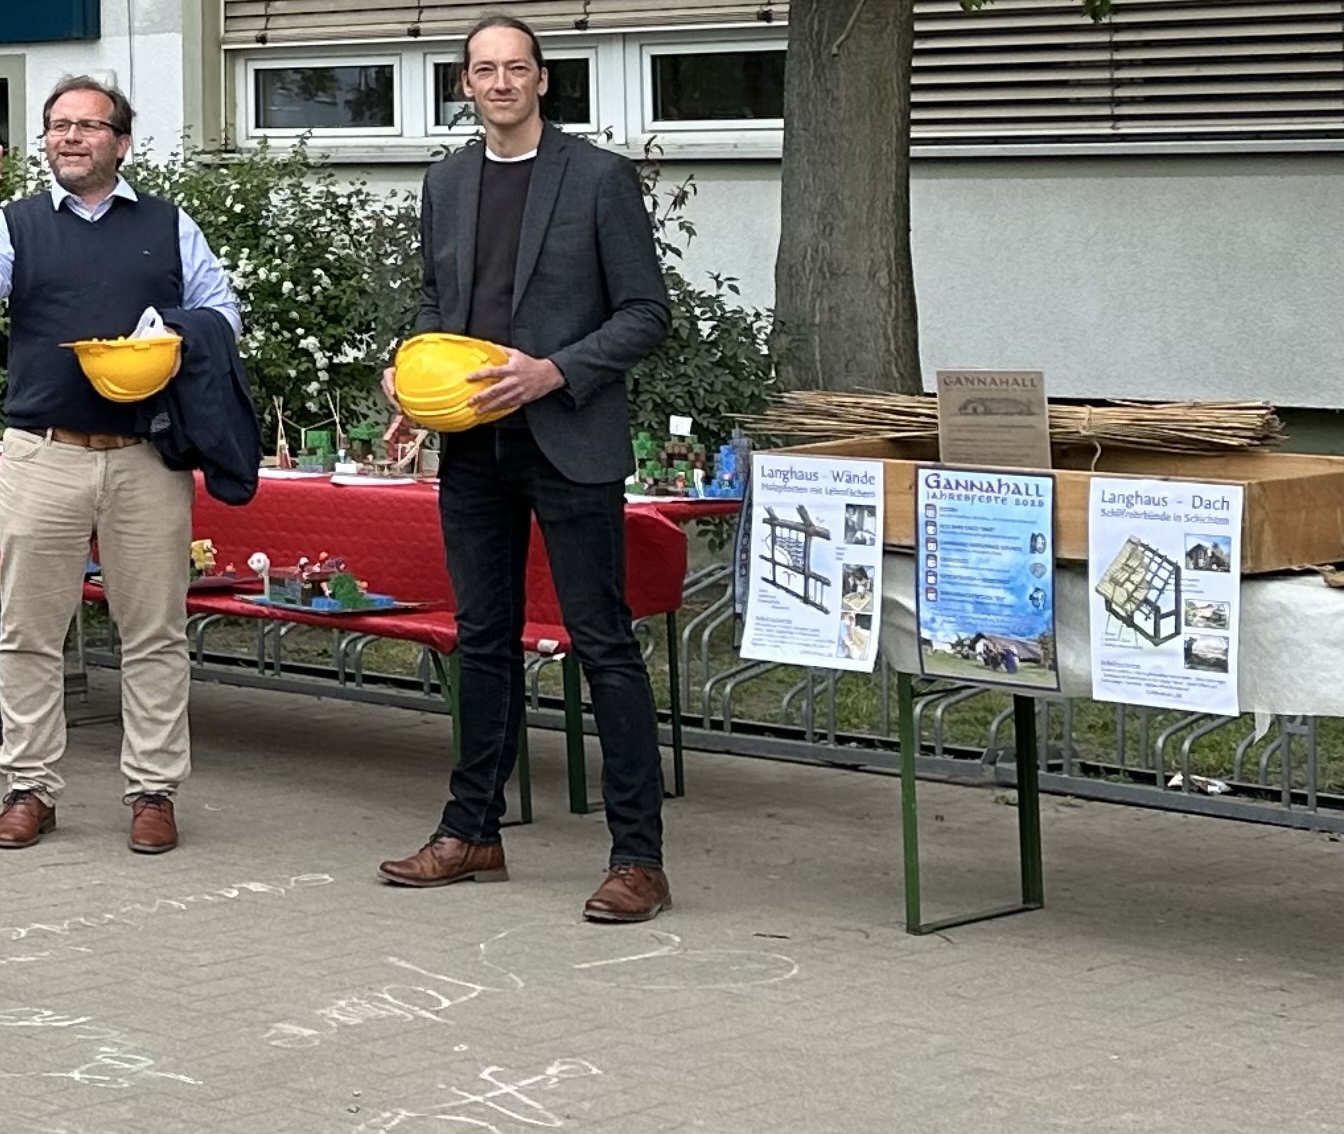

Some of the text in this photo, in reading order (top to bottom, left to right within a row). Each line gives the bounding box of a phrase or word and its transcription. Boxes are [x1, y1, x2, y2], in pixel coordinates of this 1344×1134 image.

[943, 375, 1038, 388] GANNAHALL
[761, 465, 819, 483] Langhaus
[831, 470, 876, 485] Wände
[1101, 489, 1168, 508] Langhaus
[1192, 495, 1230, 511] Dach
